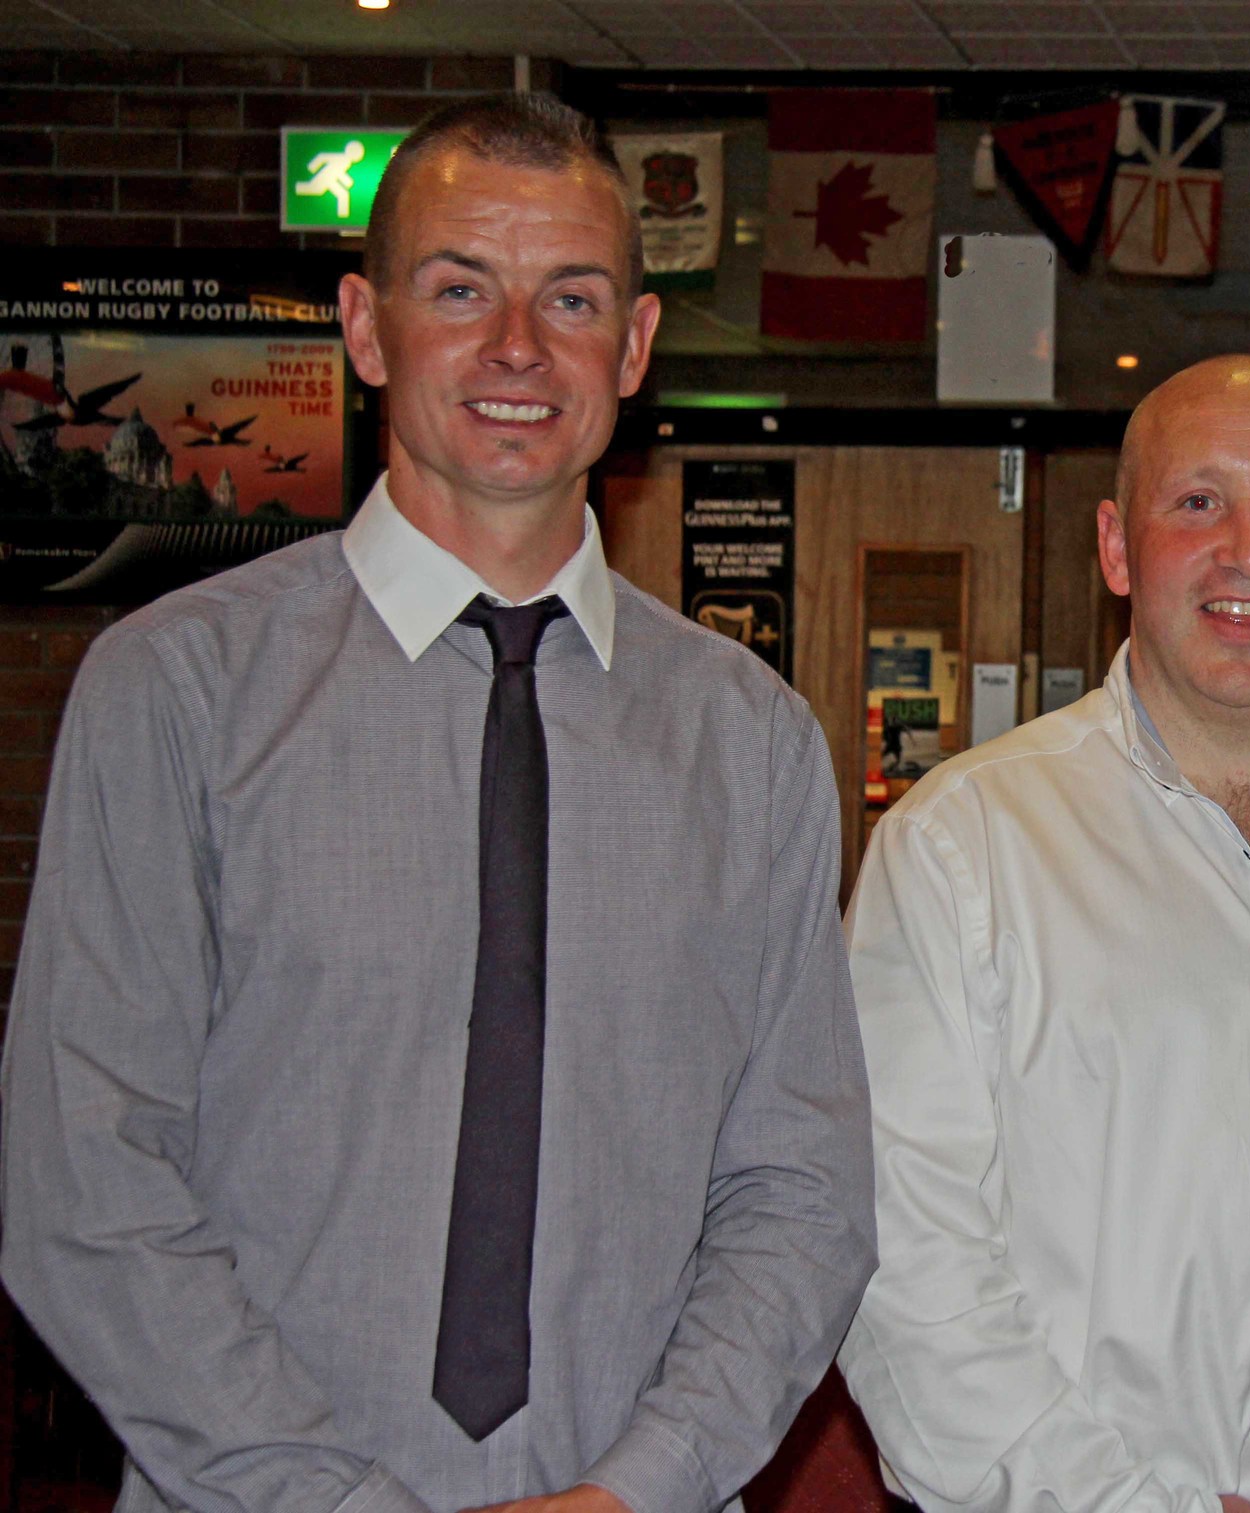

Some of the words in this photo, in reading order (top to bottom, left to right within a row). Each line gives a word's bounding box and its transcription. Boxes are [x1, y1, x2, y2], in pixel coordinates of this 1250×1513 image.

[77, 276, 185, 297] WELCOME
[192, 277, 220, 298] TO
[97, 301, 172, 320] RUGBY
[178, 302, 288, 322] FOOTBALL
[267, 361, 333, 377] THAT'S
[211, 378, 333, 398] GUINNESS
[288, 401, 333, 417] TIME
[694, 499, 760, 511] DOWNLOAD
[761, 499, 783, 511] THE
[692, 543, 725, 555] YOUR
[726, 543, 783, 555] WELCOME
[720, 555, 747, 566] AND
[748, 555, 783, 567] MORE
[704, 567, 717, 578] IS
[884, 699, 937, 721] PUSH
